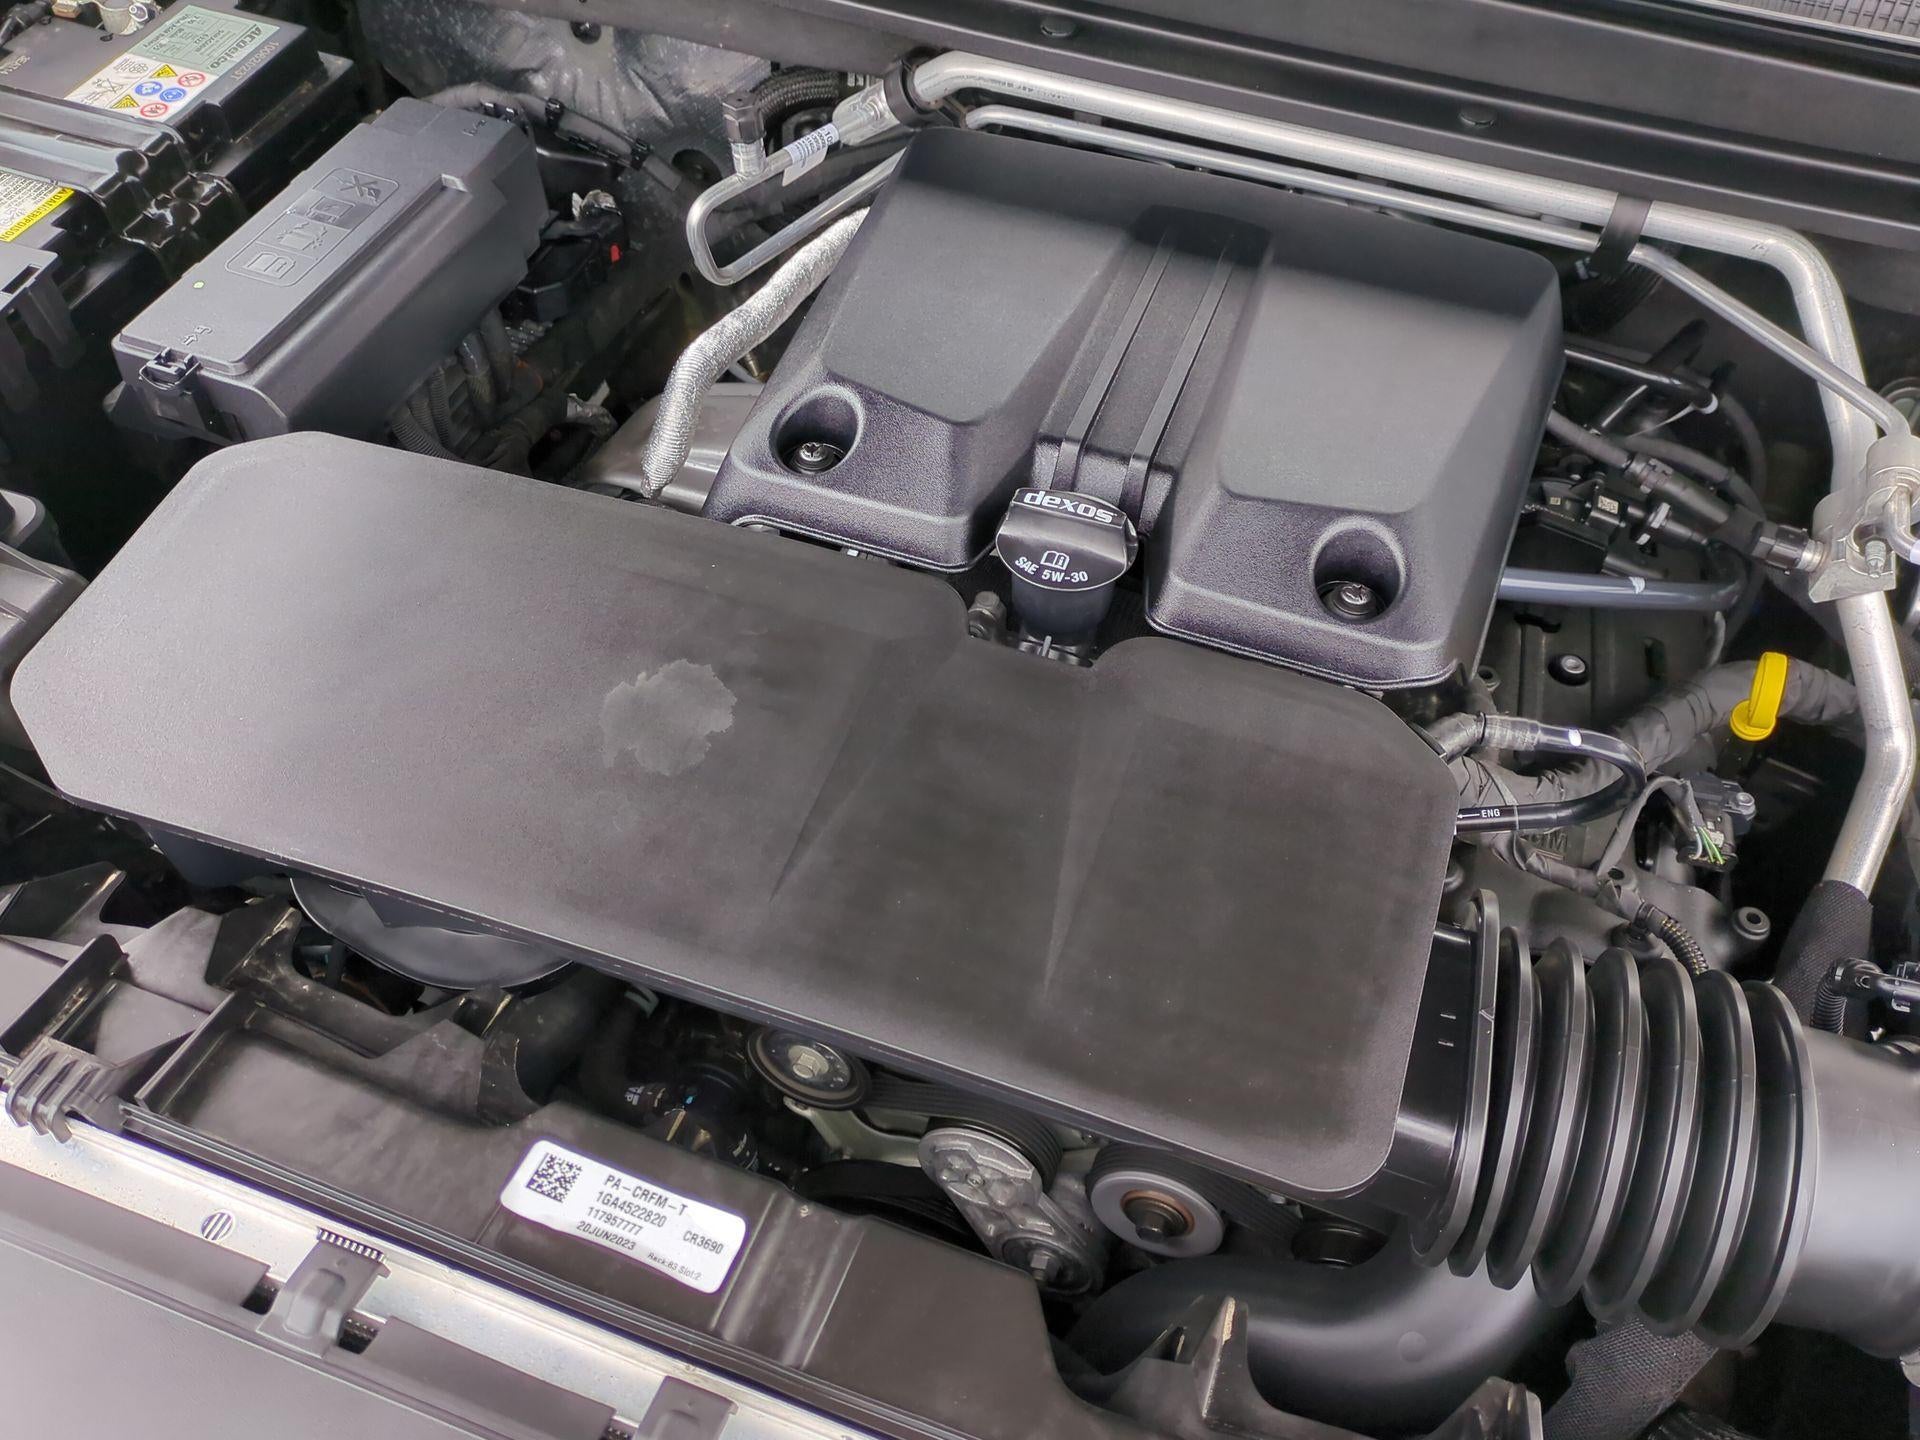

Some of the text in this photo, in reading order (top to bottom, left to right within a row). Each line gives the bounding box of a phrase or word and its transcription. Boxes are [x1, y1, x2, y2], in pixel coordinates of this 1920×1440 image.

[208, 26, 264, 69] ACDelco
[1023, 490, 1114, 524] dexos
[1014, 556, 1089, 583] SAE 5W-30
[1481, 808, 1501, 818] ENG
[595, 1191, 668, 1228] 1GA4522820
[604, 1174, 689, 1217] PA-CRFM-T
[576, 1220, 637, 1251] 20JUN2023
[586, 1206, 644, 1237] 117957777
[682, 1230, 724, 1255] CR3690
